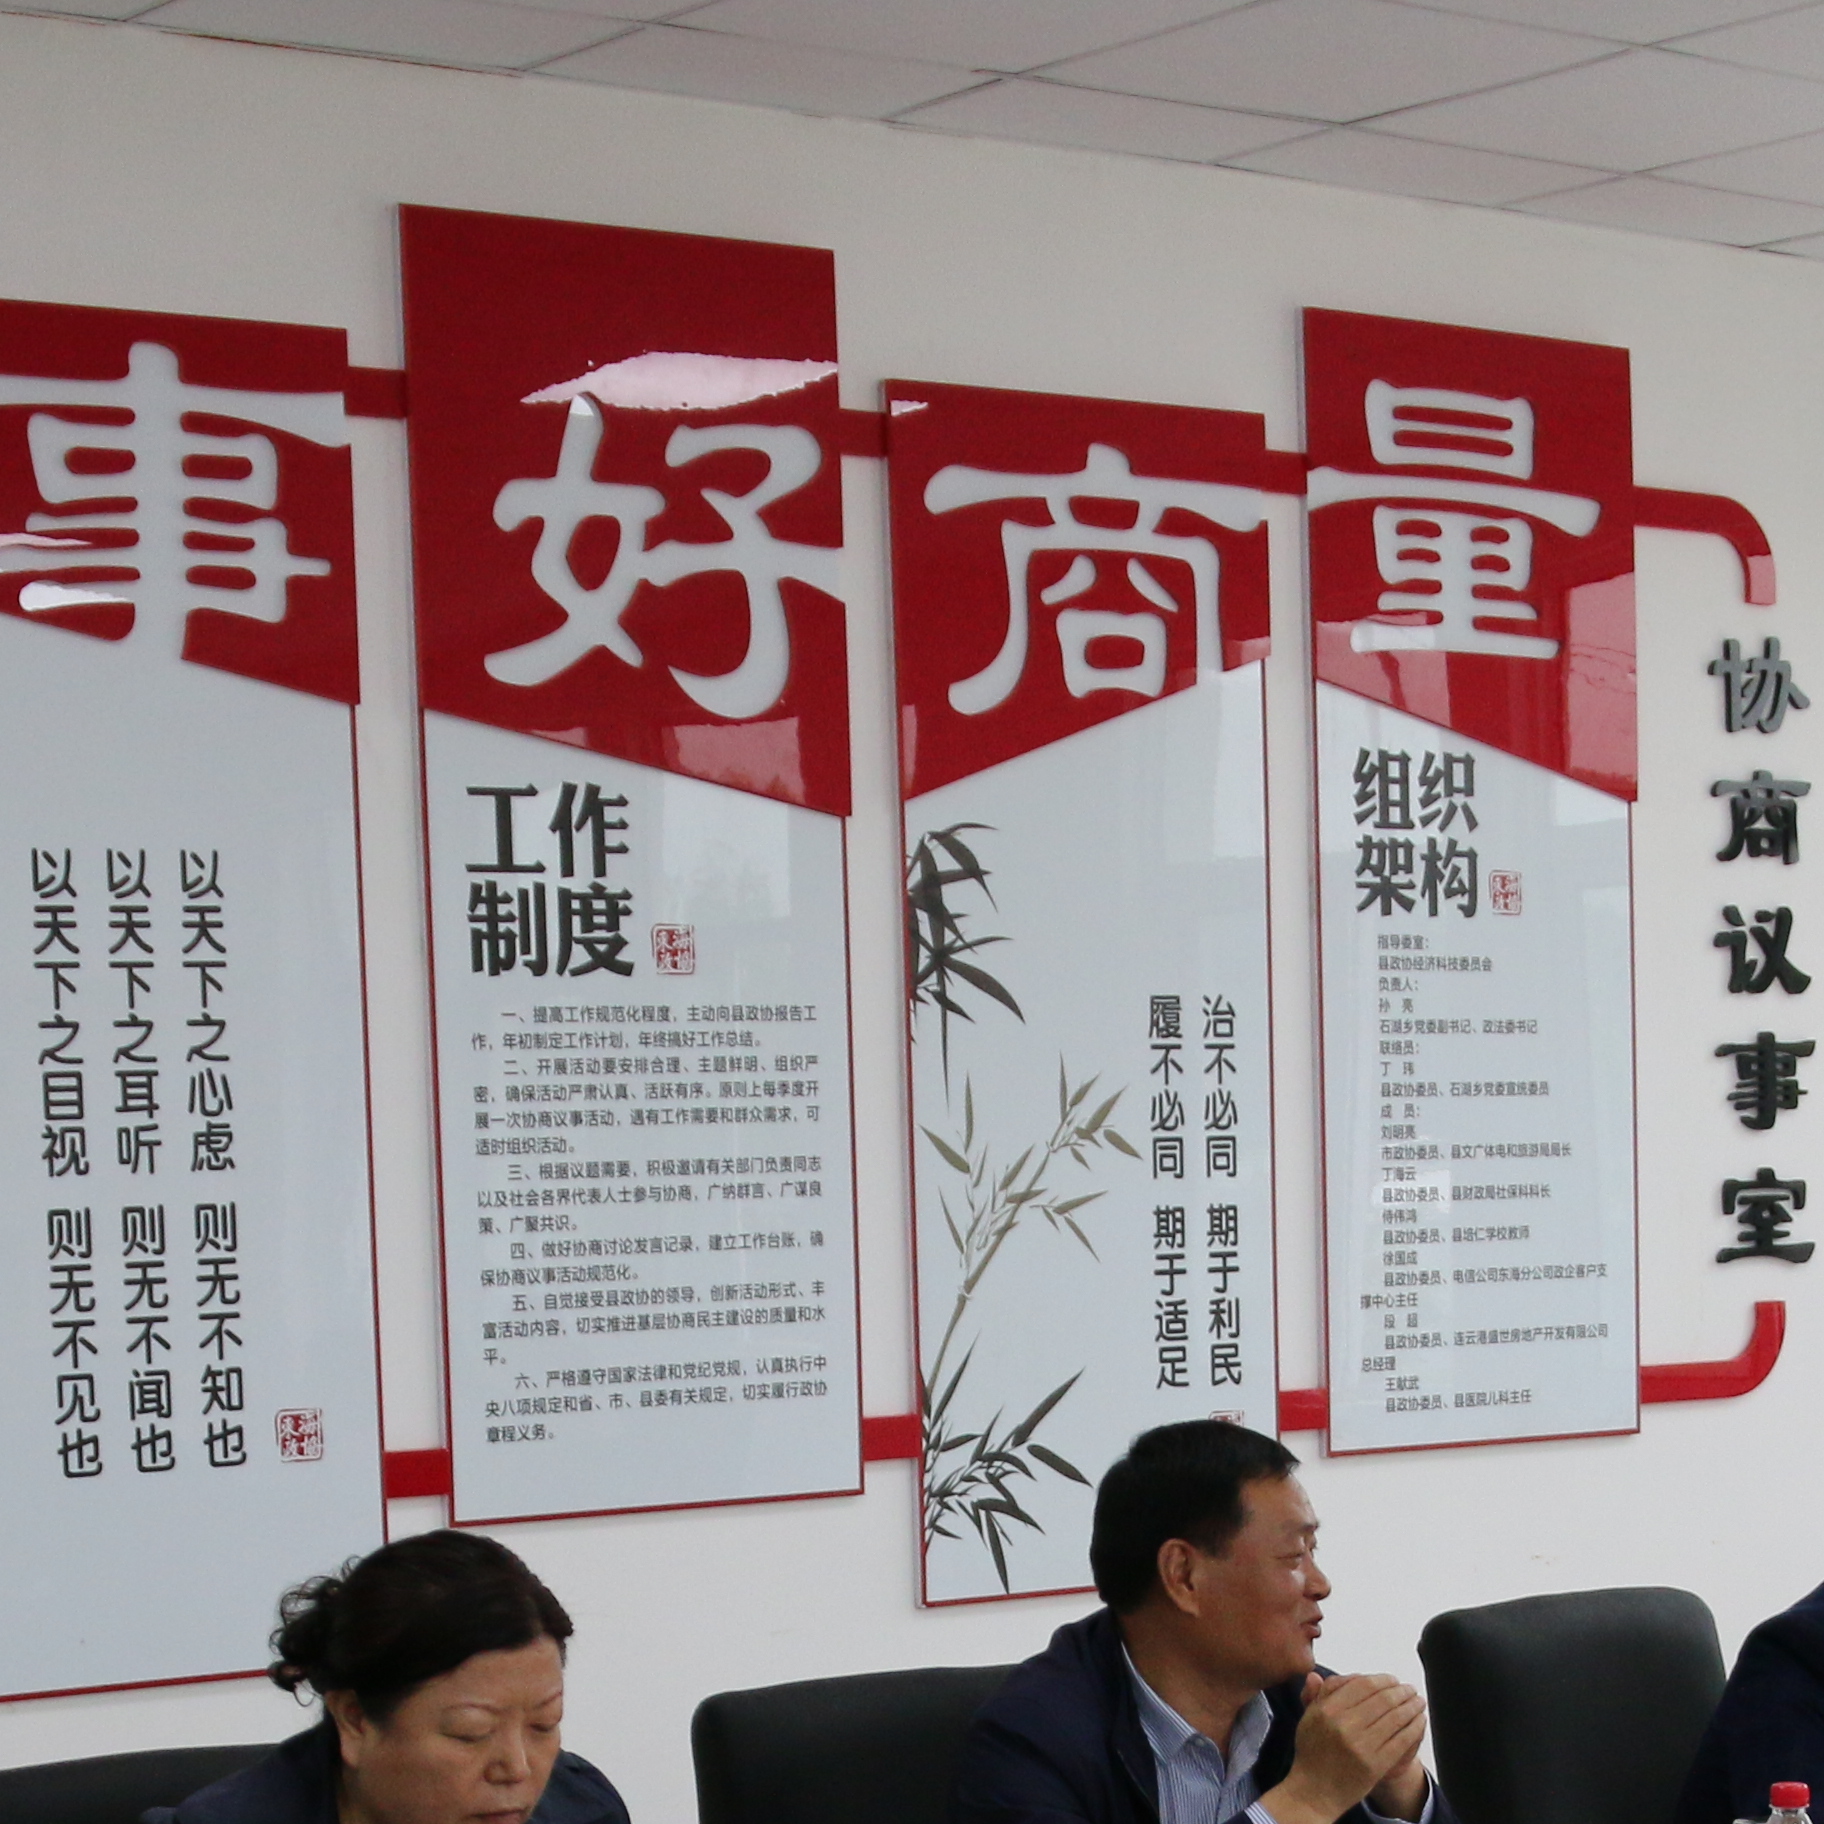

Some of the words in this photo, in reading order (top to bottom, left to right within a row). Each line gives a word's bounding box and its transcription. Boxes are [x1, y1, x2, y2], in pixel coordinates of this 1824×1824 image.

[465, 781, 629, 879] 工作
[1352, 748, 1479, 834] 组织
[1354, 835, 1479, 918] 架构
[31, 847, 89, 1177] 以天下之目视
[106, 847, 163, 1175] 以天下之耳听
[179, 848, 235, 1172] 以天下之心虑
[466, 880, 635, 978] 制度
[1707, 636, 1816, 1265] 协商议事室
[1149, 994, 1185, 1181] 履不必同
[1202, 994, 1238, 1179] 治不必同
[47, 1208, 103, 1479] 则无不见也
[121, 1205, 175, 1474] 则无不闻也
[194, 1202, 247, 1468] 则无不知也
[1152, 1205, 1190, 1391] 期于适足
[1206, 1203, 1242, 1387] 期于利民
